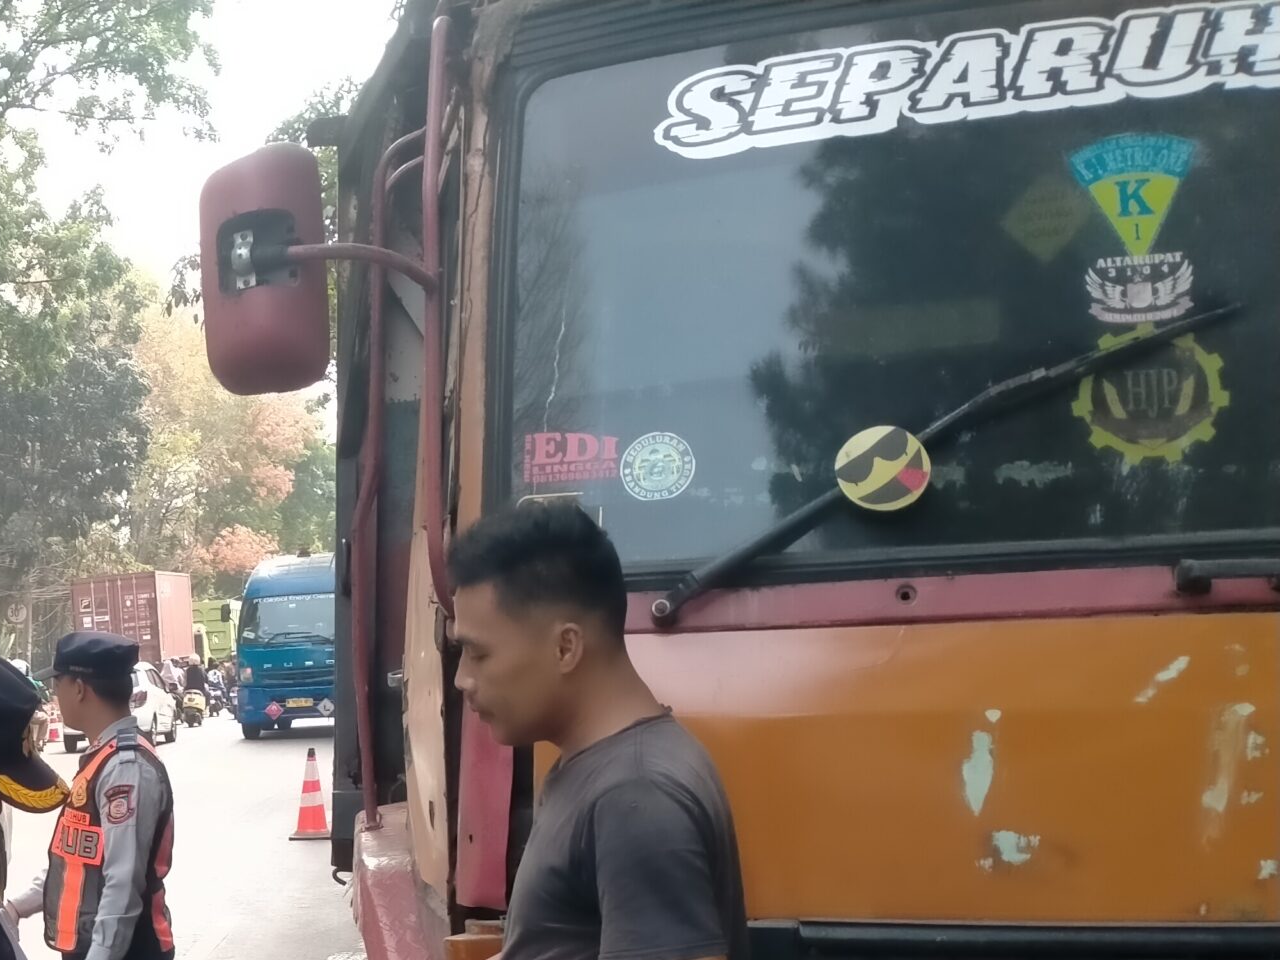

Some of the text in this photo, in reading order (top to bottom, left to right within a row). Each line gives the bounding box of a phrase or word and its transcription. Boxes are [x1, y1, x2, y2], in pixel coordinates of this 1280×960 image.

[654, 2, 1280, 159] SEPARUH
[1114, 178, 1155, 218] K
[532, 431, 619, 465] EDI
